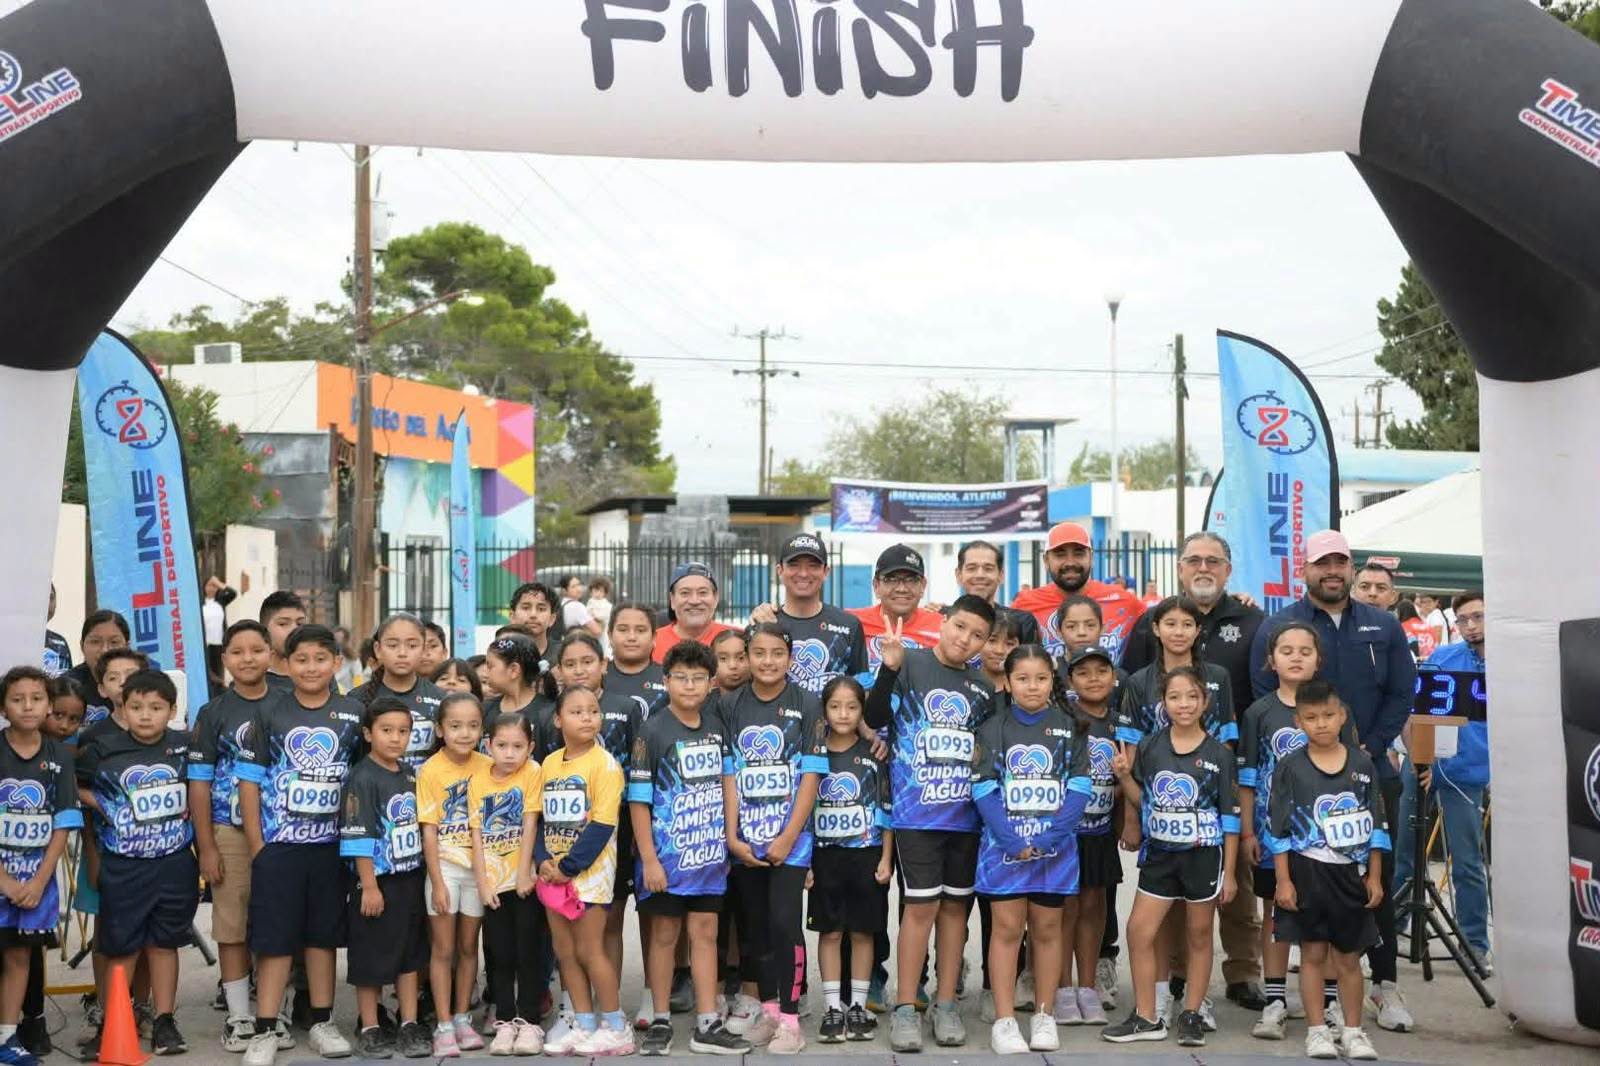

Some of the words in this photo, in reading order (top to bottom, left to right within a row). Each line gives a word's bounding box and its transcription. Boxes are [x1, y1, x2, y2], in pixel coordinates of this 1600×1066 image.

[156, 474, 177, 582] DEPORTIVO
[928, 734, 972, 756] 0993
[684, 750, 721, 772] 0954
[744, 771, 789, 792] 0953
[136, 790, 184, 814] 0961
[291, 787, 339, 807] 0980
[1008, 786, 1056, 805] 0990
[3, 820, 50, 840] 1039
[817, 812, 863, 832] 0986
[1150, 815, 1194, 838] 0985
[1329, 817, 1372, 842] 1010
[680, 843, 724, 867] AGUA
